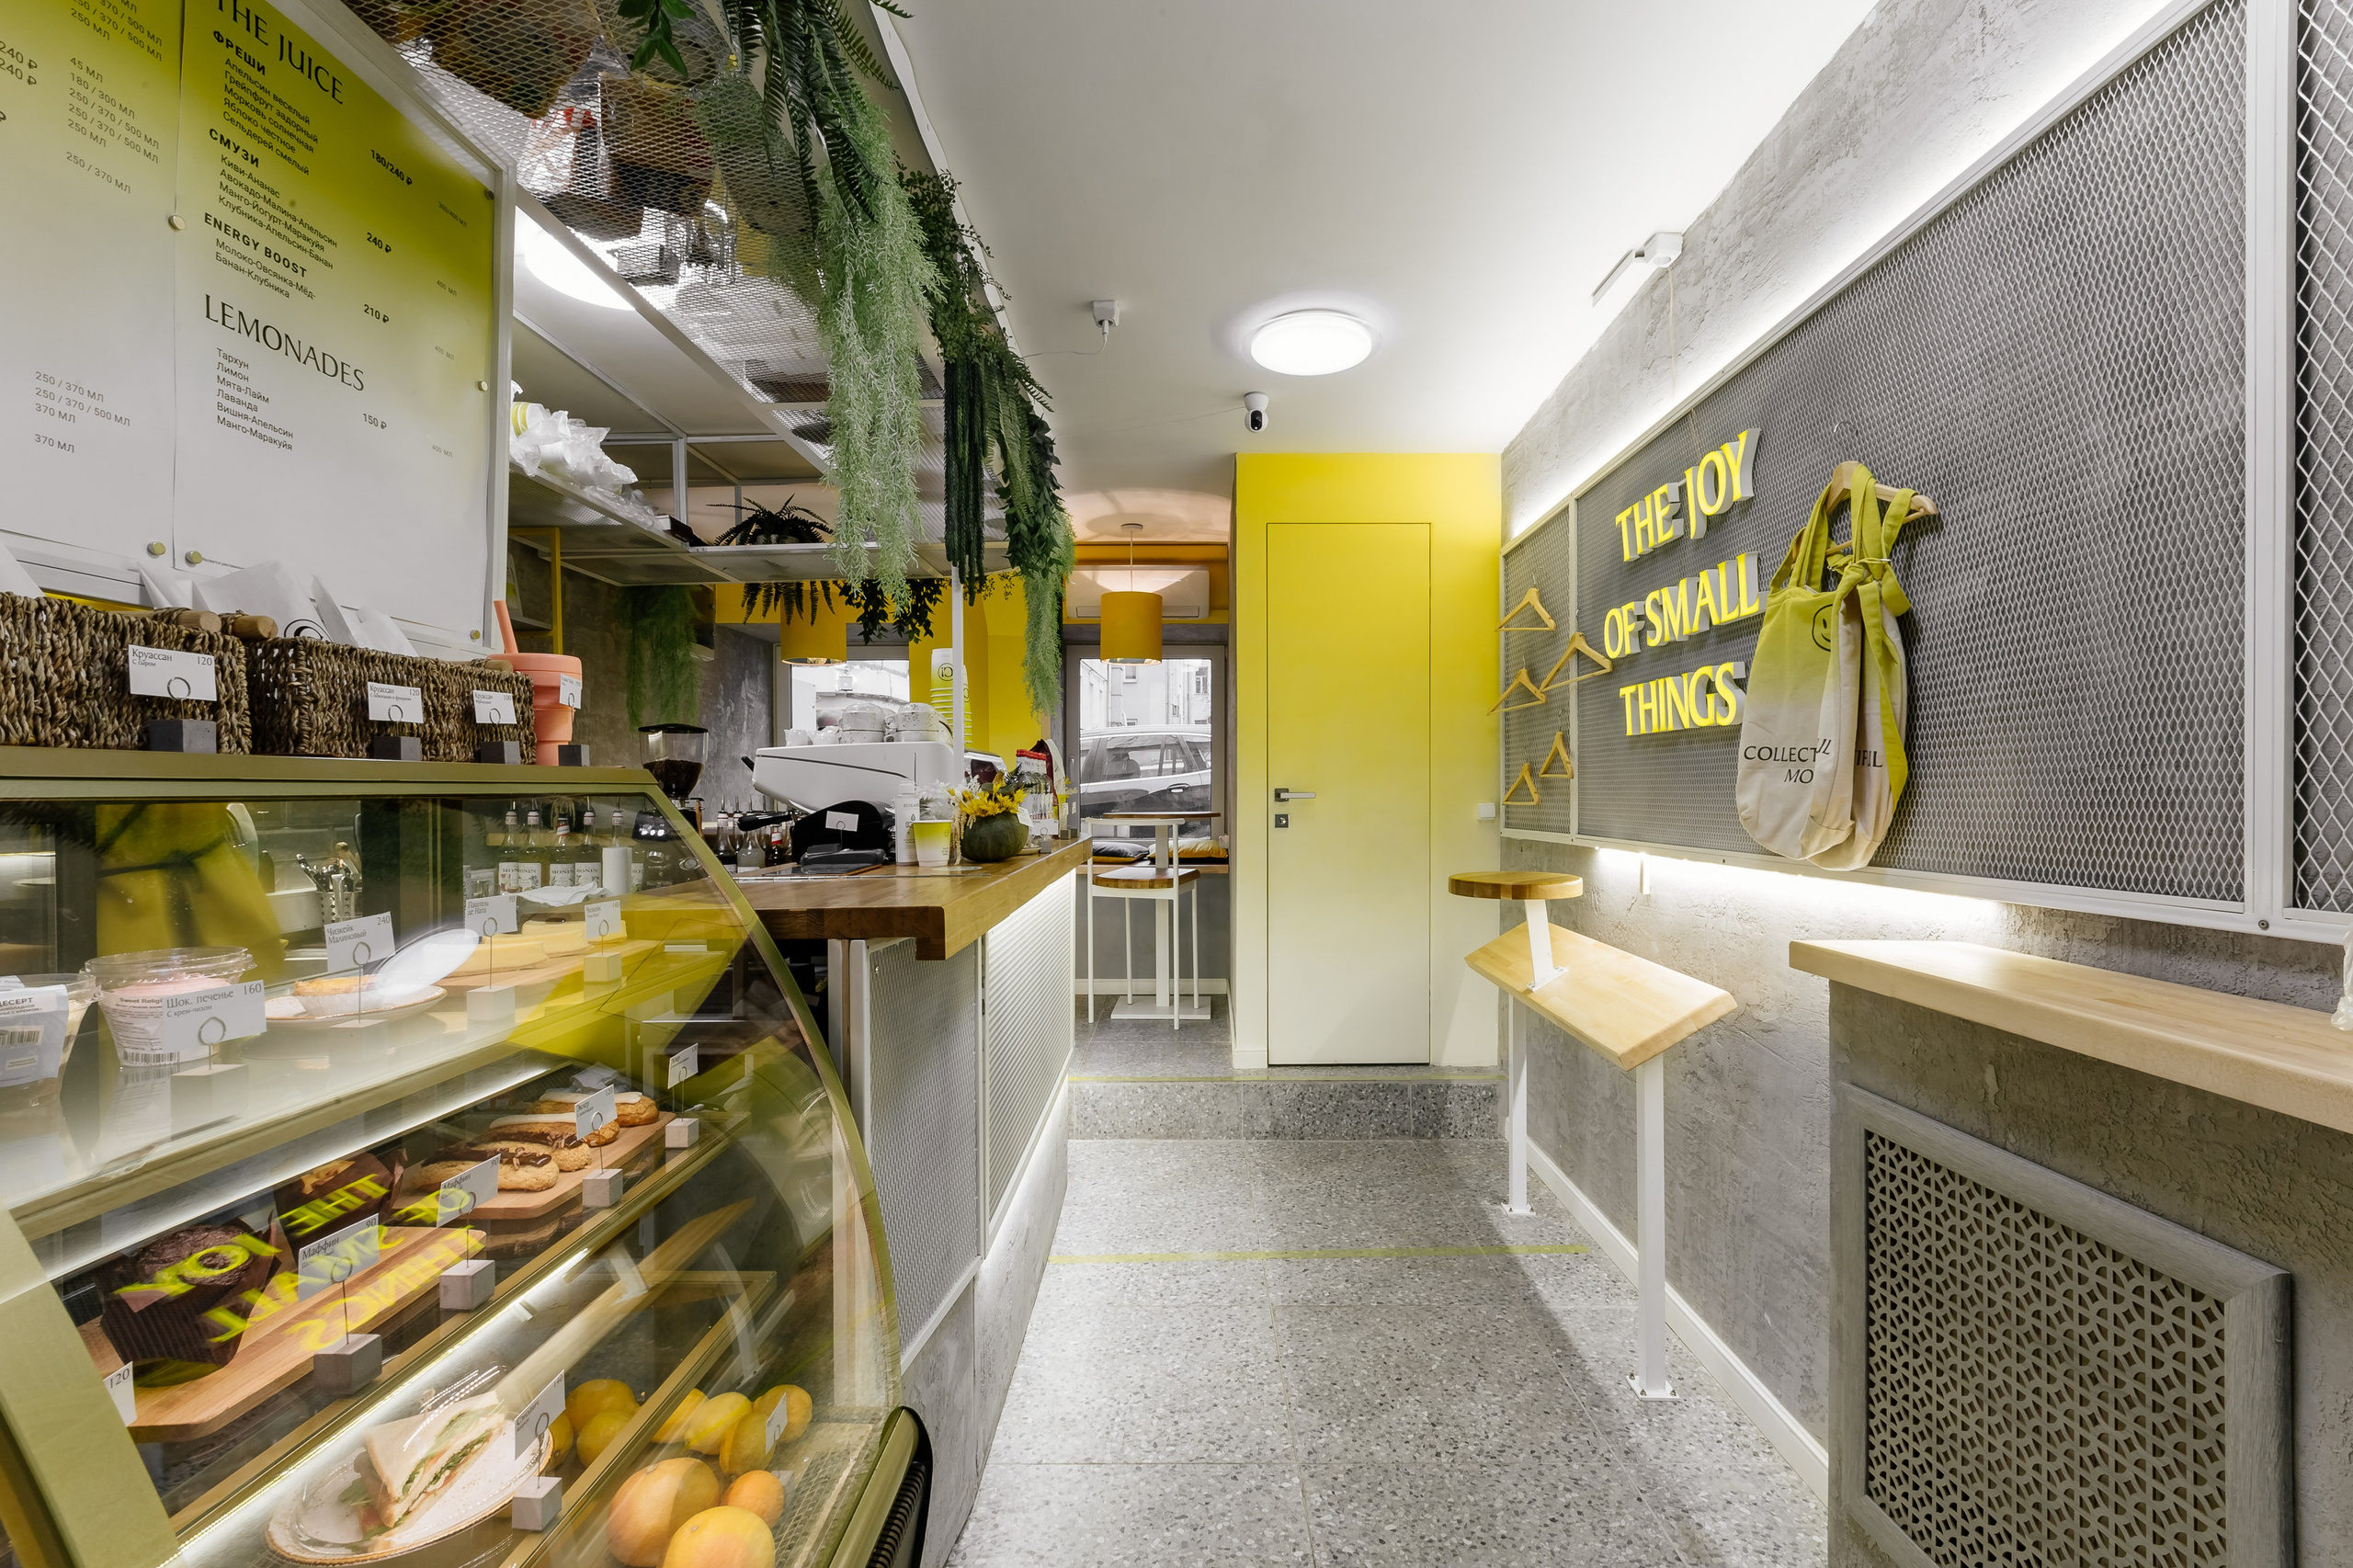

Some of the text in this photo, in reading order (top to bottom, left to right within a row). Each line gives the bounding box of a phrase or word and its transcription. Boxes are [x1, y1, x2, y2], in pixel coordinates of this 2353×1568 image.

[71, 8, 110, 40] 250 МЛ
[74, 0, 162, 62] 50 370 500 МЛ
[128, 17, 144, 33] 500
[147, 30, 162, 47] МЛ
[0, 41, 24, 63] 240
[0, 58, 22, 80] 240
[70, 57, 103, 83] 45 МЛ
[213, 30, 265, 75] ФРЕШИ
[279, 33, 343, 105] JUICE
[71, 73, 135, 119] 180 300 МЛ
[225, 58, 310, 125] Апельсин веселый
[225, 70, 318, 143] Грейпфрут задорный
[68, 119, 106, 147] 250 МЛ
[69, 103, 158, 164] 250 370 500 МЛ
[70, 88, 159, 149] 250 370 500 МЛ
[223, 97, 295, 153] Яблоко честное
[224, 84, 313, 153] Морковь солнечная
[210, 128, 259, 168] СМУЗИ
[223, 111, 309, 176] Сельдерей смелый
[66, 152, 131, 194] 250 370 МЛ
[221, 154, 280, 199] Киви-Ананас
[370, 150, 404, 181] 180/240
[220, 181, 324, 253] Манго-Йогурт-Маракуйя
[221, 169, 337, 248] Авокадо-Малина-Апельсин
[204, 212, 307, 278] ENERGY BOOST
[219, 195, 333, 269] Клубника-Апельсин-Банан
[367, 233, 382, 249] 240
[215, 252, 290, 299] Банан-Клубника
[364, 304, 380, 320] 210
[205, 294, 364, 391] LEMONADES
[217, 347, 249, 369] Тархун
[36, 371, 104, 403] 250 370 МЛ
[217, 362, 249, 382] Лимон
[217, 375, 269, 403] Мята-Лайм
[35, 387, 131, 426] 250 370 500 МЛ
[35, 403, 75, 423] 370 МЛ
[217, 389, 258, 413] Лаванда
[217, 402, 294, 438] Вишня-Апельсин
[217, 415, 292, 451] Манго-Маракуйя
[363, 414, 378, 426] 150
[35, 434, 74, 453] 370 МЛ
[1615, 428, 1762, 562] THE JOY
[1605, 551, 1766, 659] OF SMALL
[132, 649, 212, 665] Круассан 120
[1620, 661, 1746, 736] THINGS
[1784, 768, 1813, 783] MO
[327, 915, 390, 936] Чизкейк 240
[328, 930, 367, 945] Малиновый
[166, 999, 193, 1009] Шок.
[197, 991, 233, 1004] печенье
[244, 983, 262, 995] 160
[302, 1238, 339, 1260] Маффин
[366, 1218, 376, 1228] 90
[110, 1369, 130, 1389] 120
